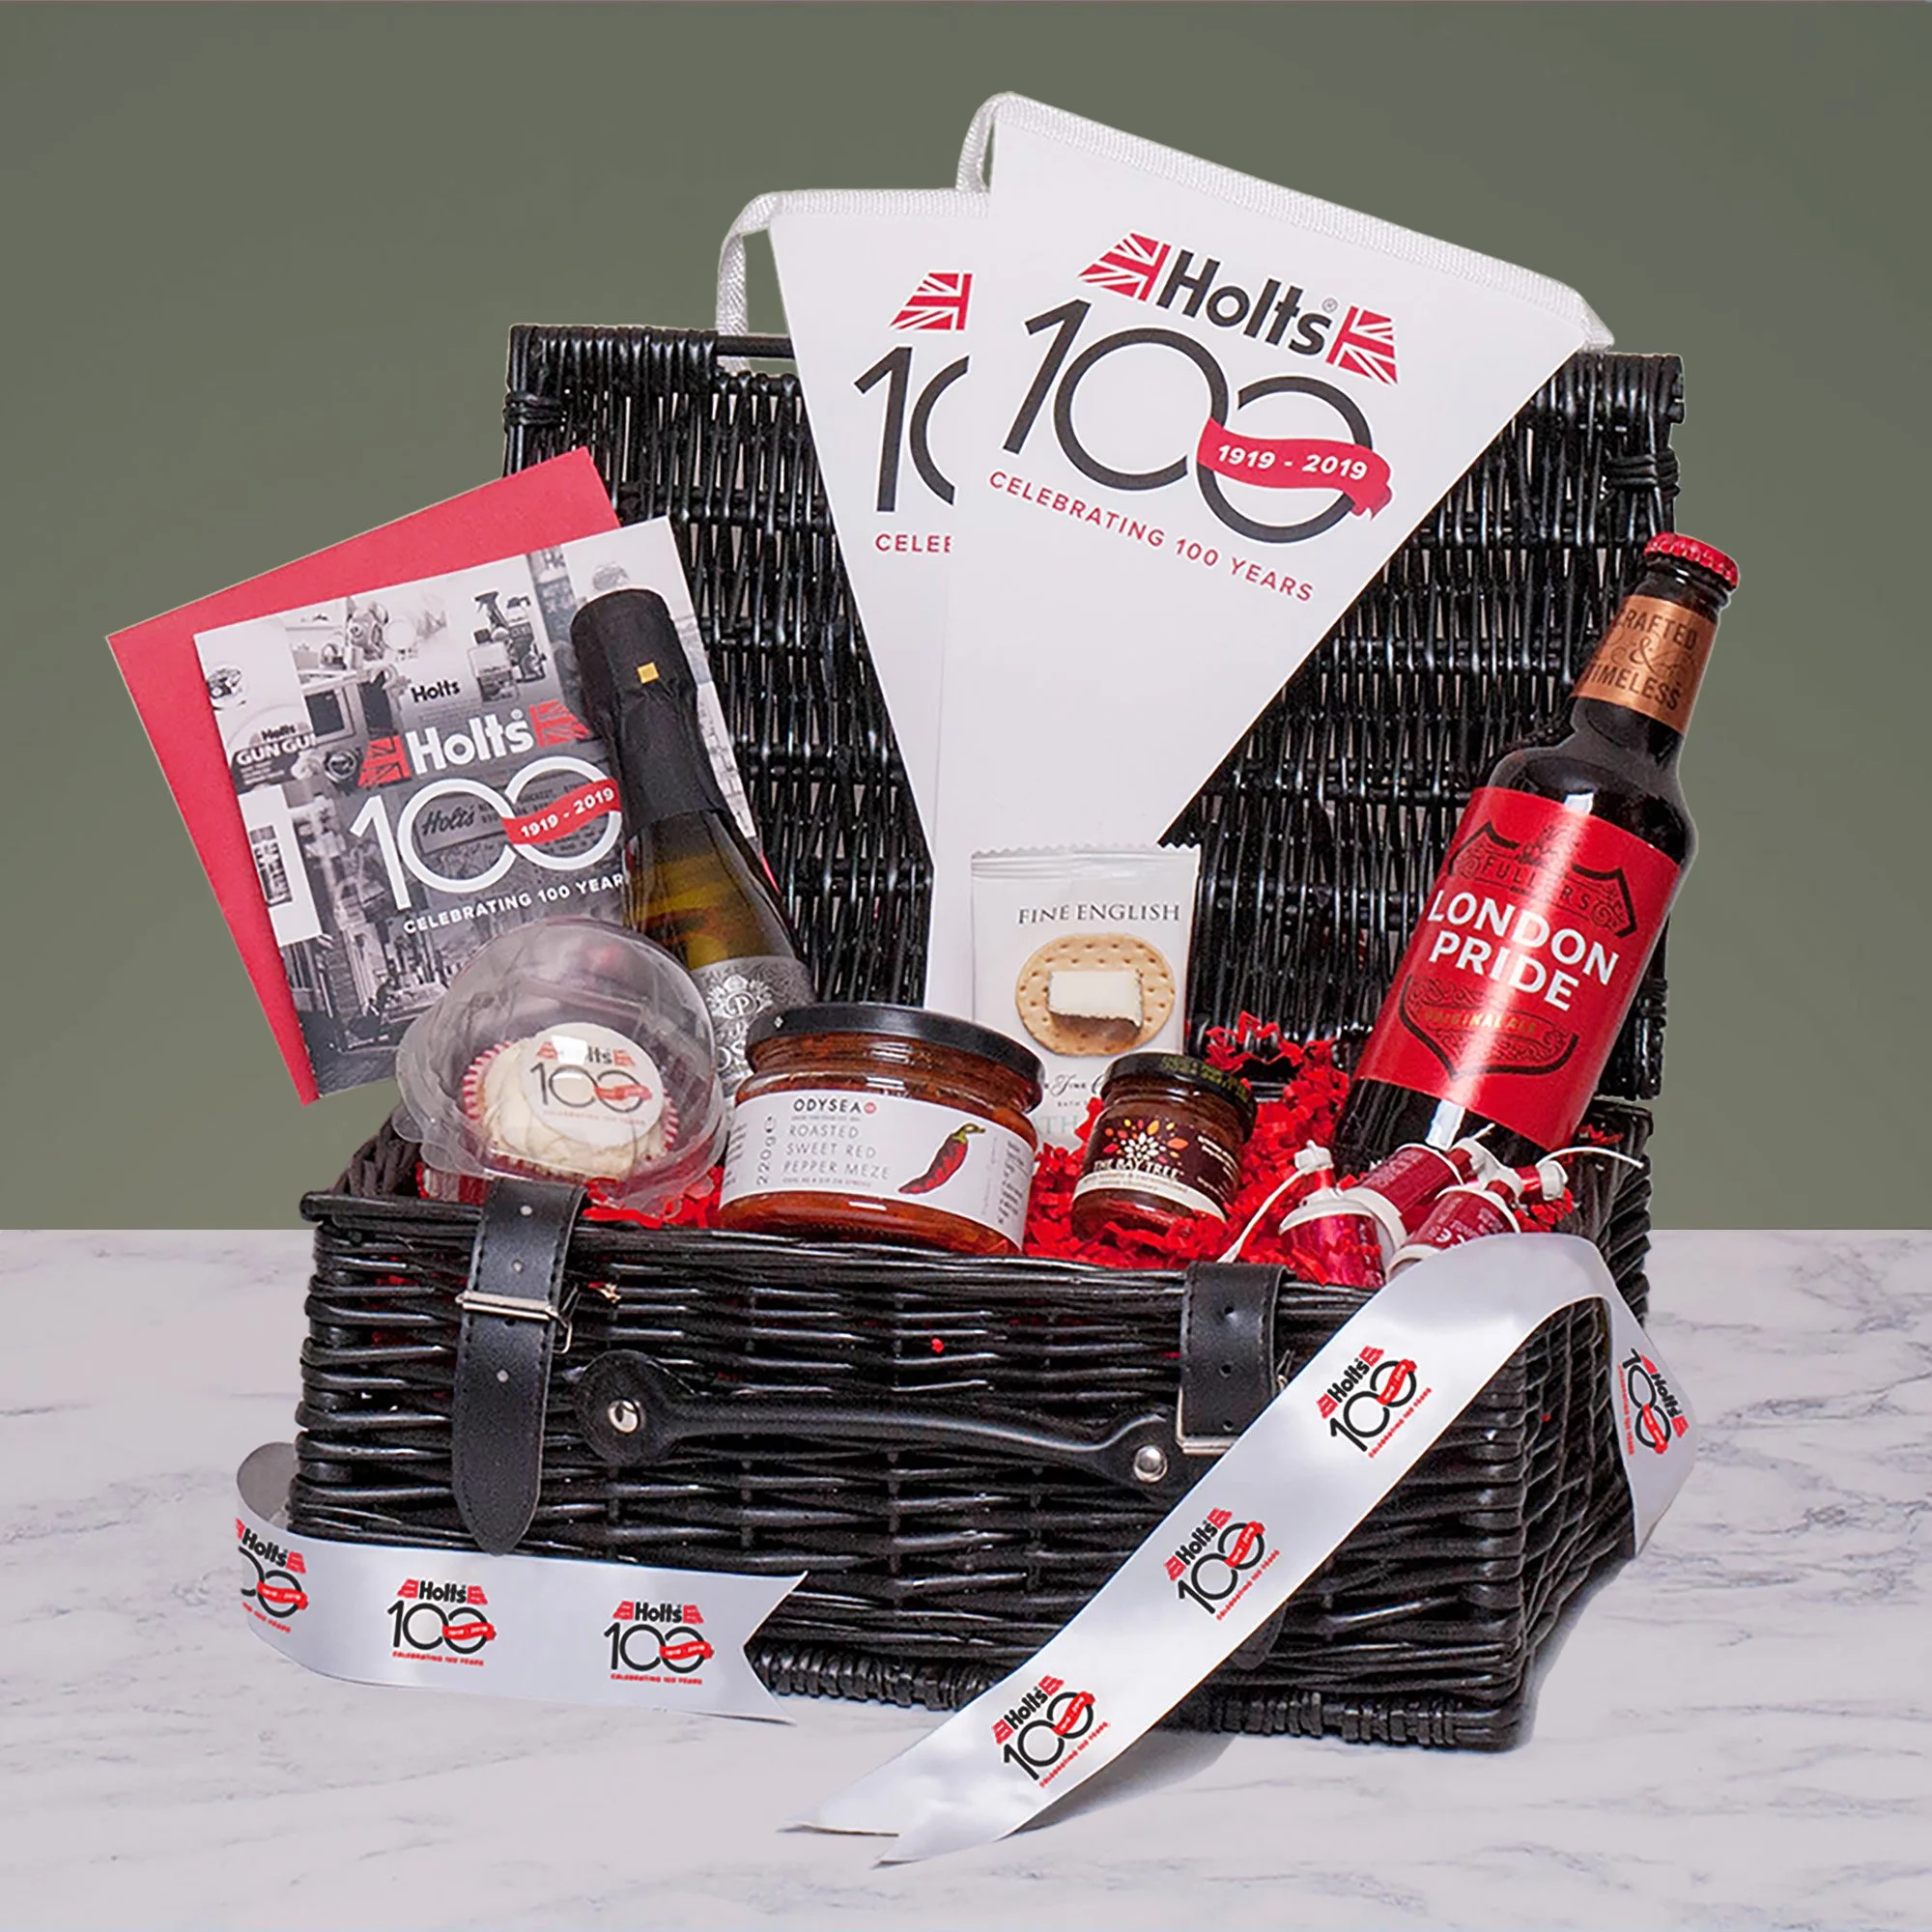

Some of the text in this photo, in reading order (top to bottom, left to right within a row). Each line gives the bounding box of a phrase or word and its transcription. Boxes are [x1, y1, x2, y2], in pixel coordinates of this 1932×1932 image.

[1002, 298, 1374, 544] 100
[1218, 444, 1275, 469] 1919
[1301, 454, 1367, 480] 2019
[988, 470, 1313, 602] CELEBRATING 100 YEARS
[1624, 609, 1698, 651] RAFTED
[411, 679, 460, 703] Holts
[236, 743, 280, 766] GUN
[406, 713, 533, 775] Holts
[522, 814, 558, 838] 1919
[573, 787, 614, 815] 2019
[350, 755, 622, 911] 100
[404, 872, 624, 934] CELEBRATING 100 YEAR
[1018, 902, 1179, 924] FINE ENGLISH
[1427, 890, 1620, 985] LONDON
[1429, 930, 1579, 1011] PRIDE
[793, 1098, 862, 1113] ODYSEA
[789, 1123, 860, 1139] ROASTED
[782, 1160, 890, 1180] PEPPER MEZE
[786, 1143, 877, 1159] SWEET RED
[1116, 1157, 1144, 1172] BAY
[1146, 1160, 1179, 1180] TREE
